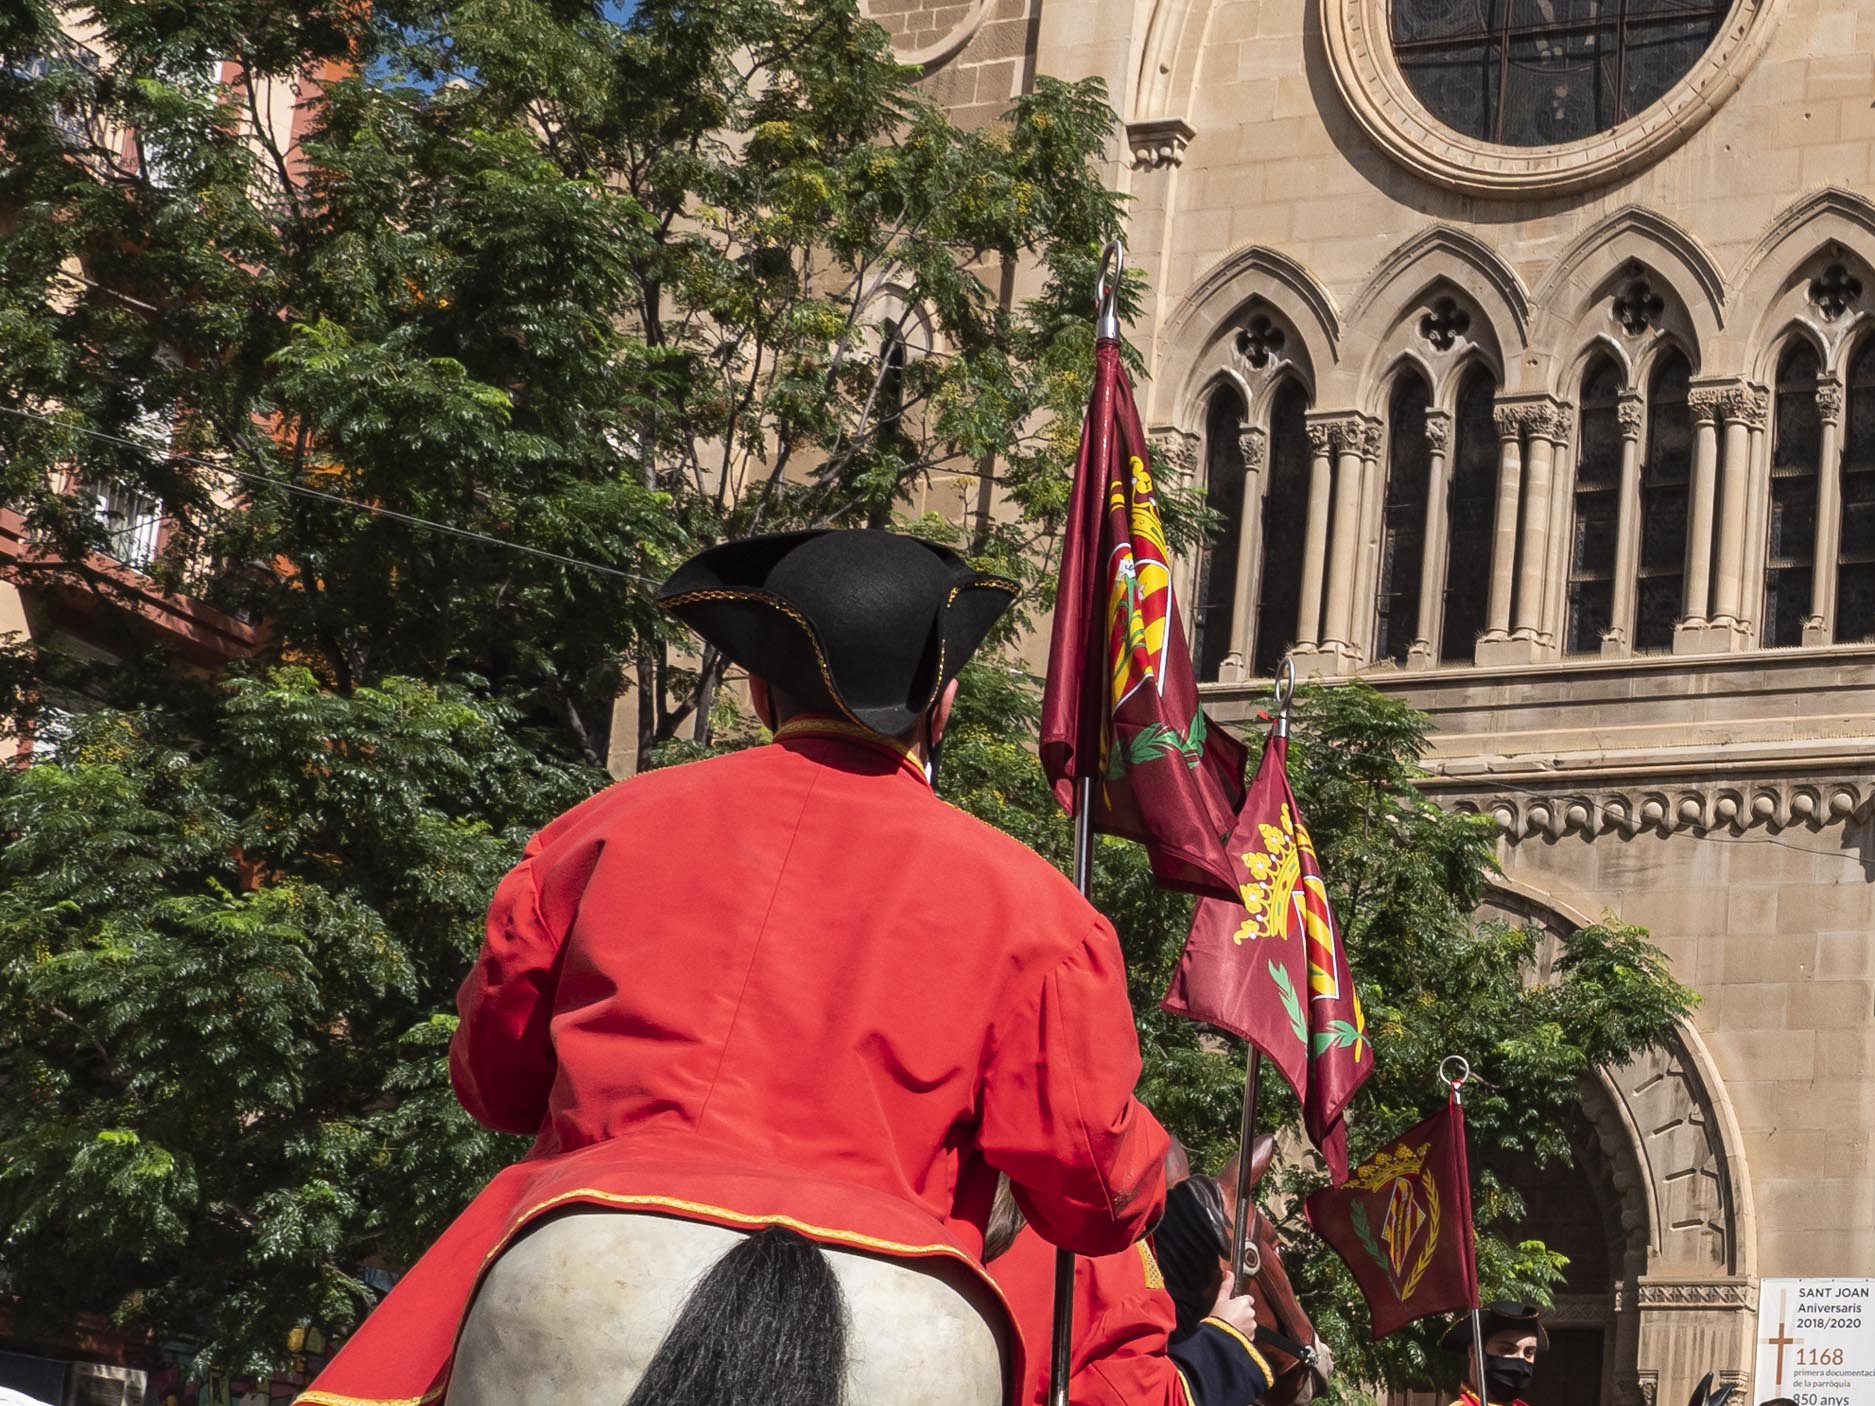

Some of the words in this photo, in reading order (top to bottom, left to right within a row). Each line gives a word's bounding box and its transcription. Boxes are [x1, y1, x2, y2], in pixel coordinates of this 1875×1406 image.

[1799, 1287, 1832, 1298] SANT
[1835, 1287, 1869, 1298] JOAN
[1797, 1302, 1862, 1313] Aniversaris
[1796, 1317, 1862, 1330] 2018/2020
[1796, 1348, 1844, 1366] 1168
[1793, 1369, 1824, 1377] primera
